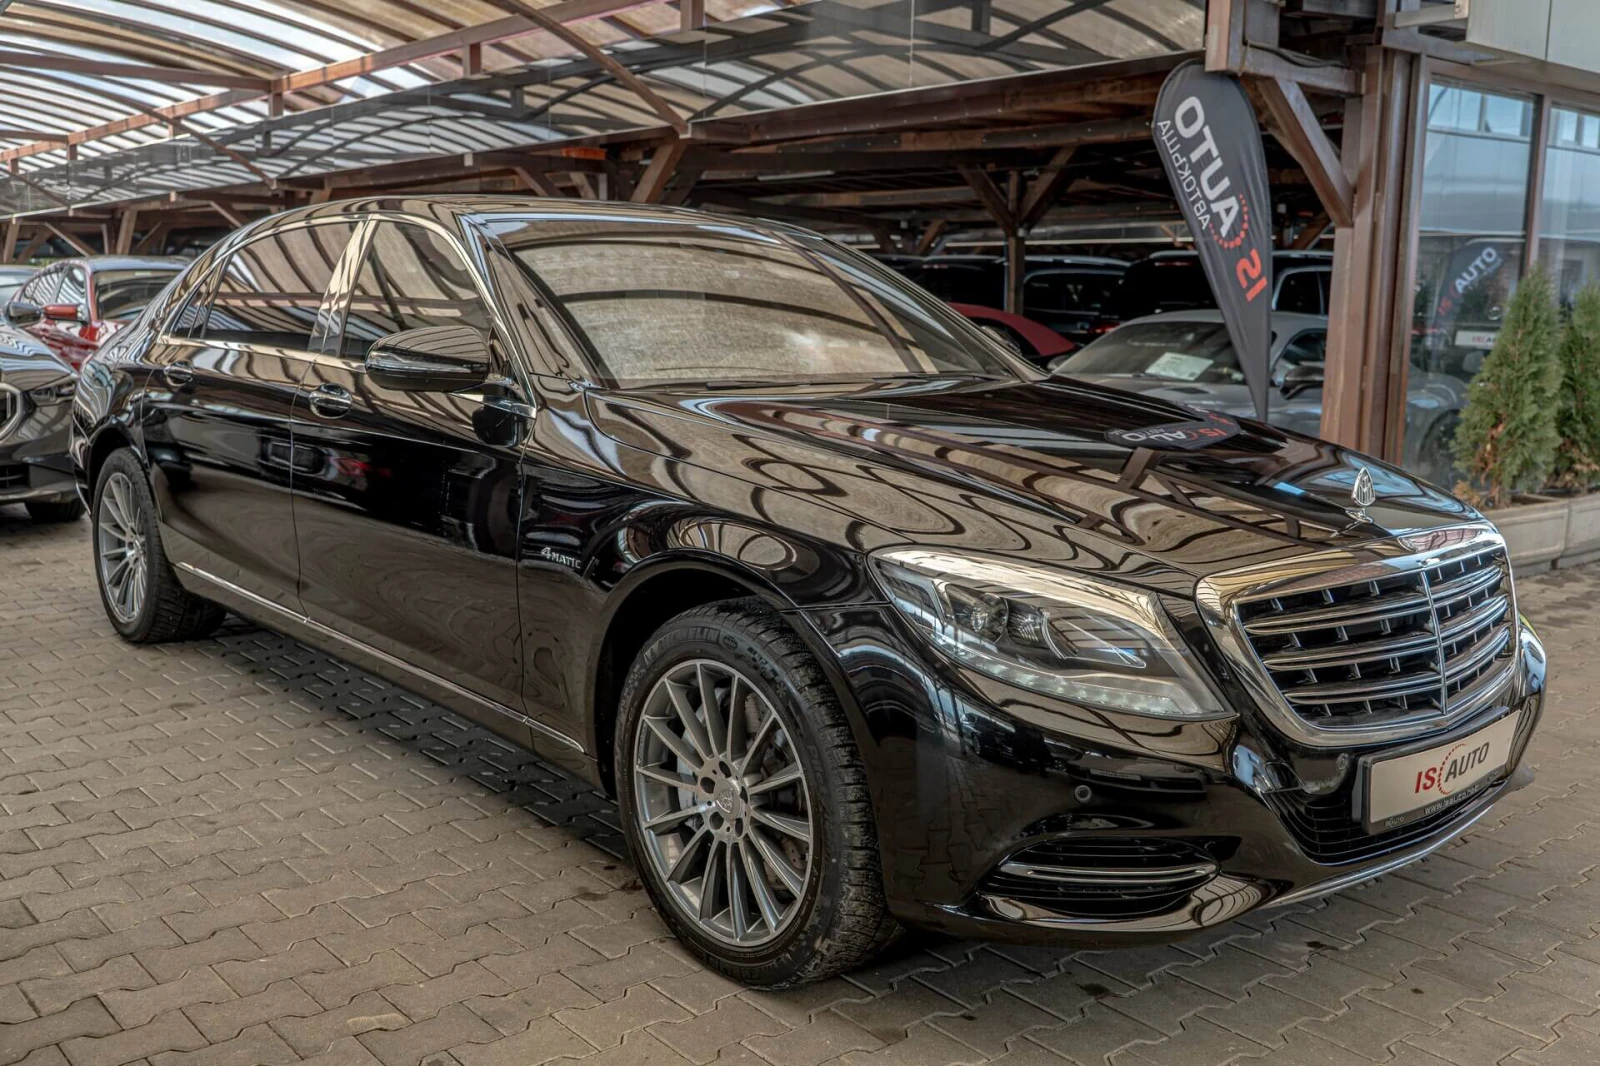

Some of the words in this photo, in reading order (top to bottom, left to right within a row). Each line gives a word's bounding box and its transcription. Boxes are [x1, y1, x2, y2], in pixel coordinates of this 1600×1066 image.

[1455, 247, 1497, 293] AUTO
[541, 546, 581, 569] 4MATIC
[1414, 766, 1437, 794] IS
[1444, 742, 1490, 783] AUTO
